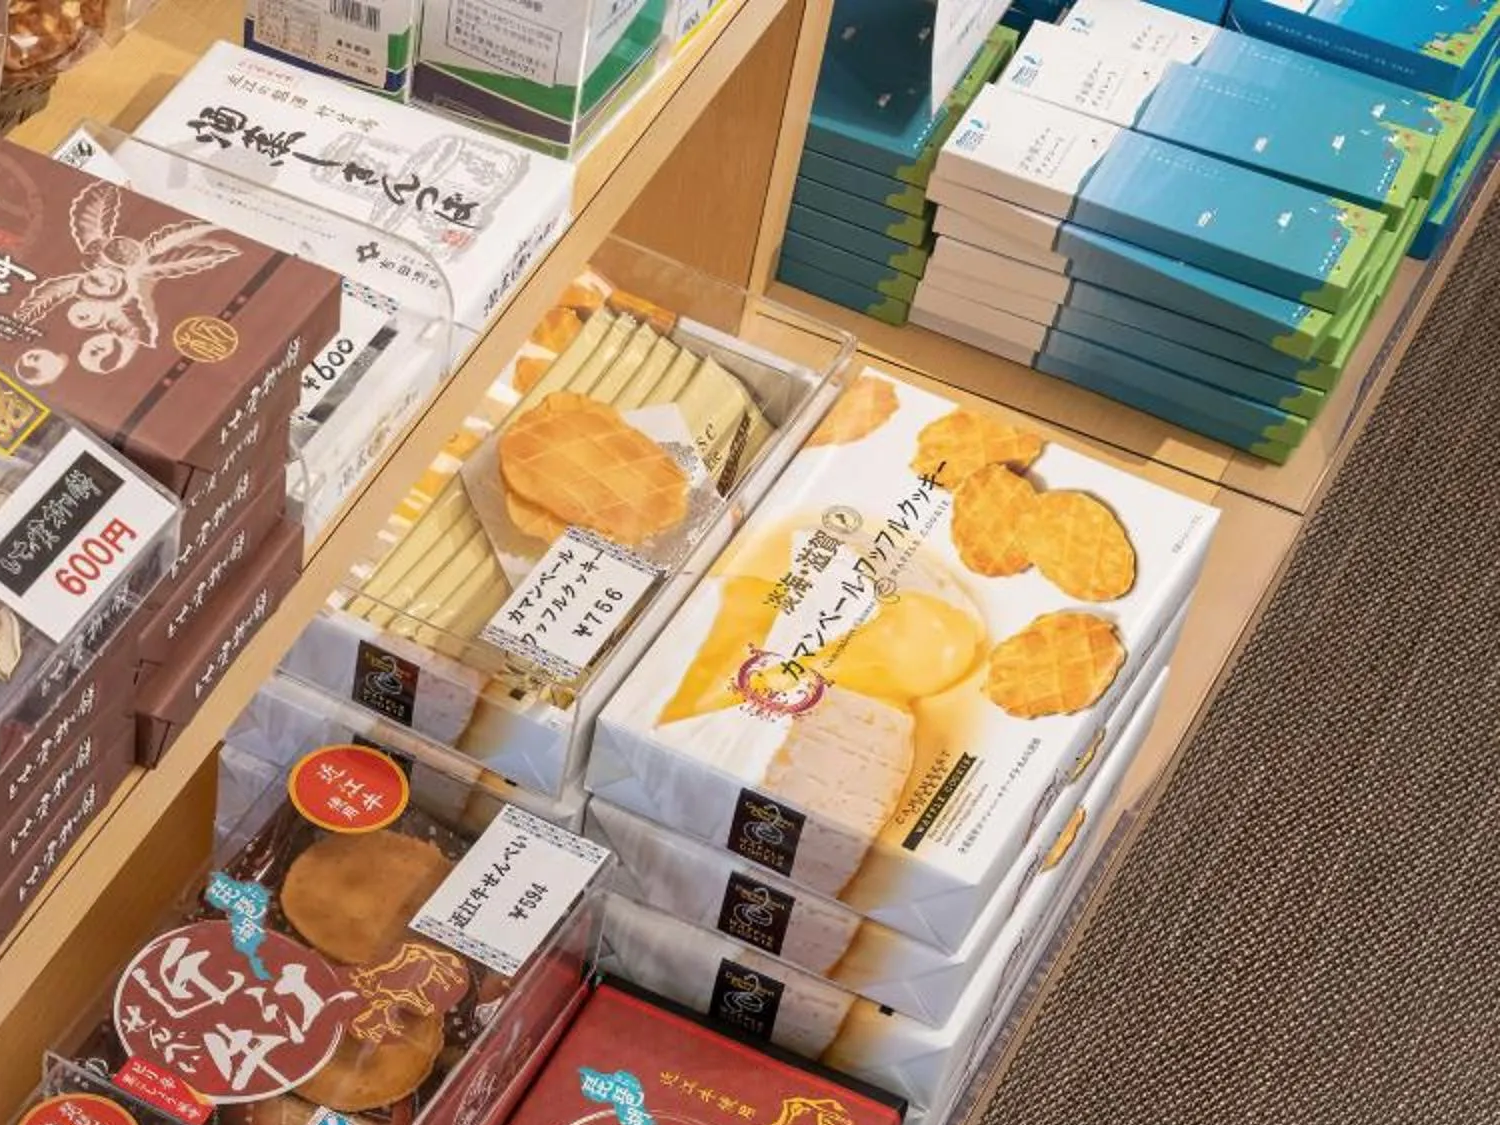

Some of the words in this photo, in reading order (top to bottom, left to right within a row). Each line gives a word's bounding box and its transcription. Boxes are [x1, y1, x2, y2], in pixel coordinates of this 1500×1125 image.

[55, 517, 138, 596] 600円
[507, 550, 575, 626] カマンベール
[522, 549, 607, 648] ワッフルクッキー
[573, 587, 624, 640] ¥756
[316, 762, 388, 812] 近江牛
[452, 835, 528, 929] 近江牛せんべい
[508, 882, 549, 921] ¥594
